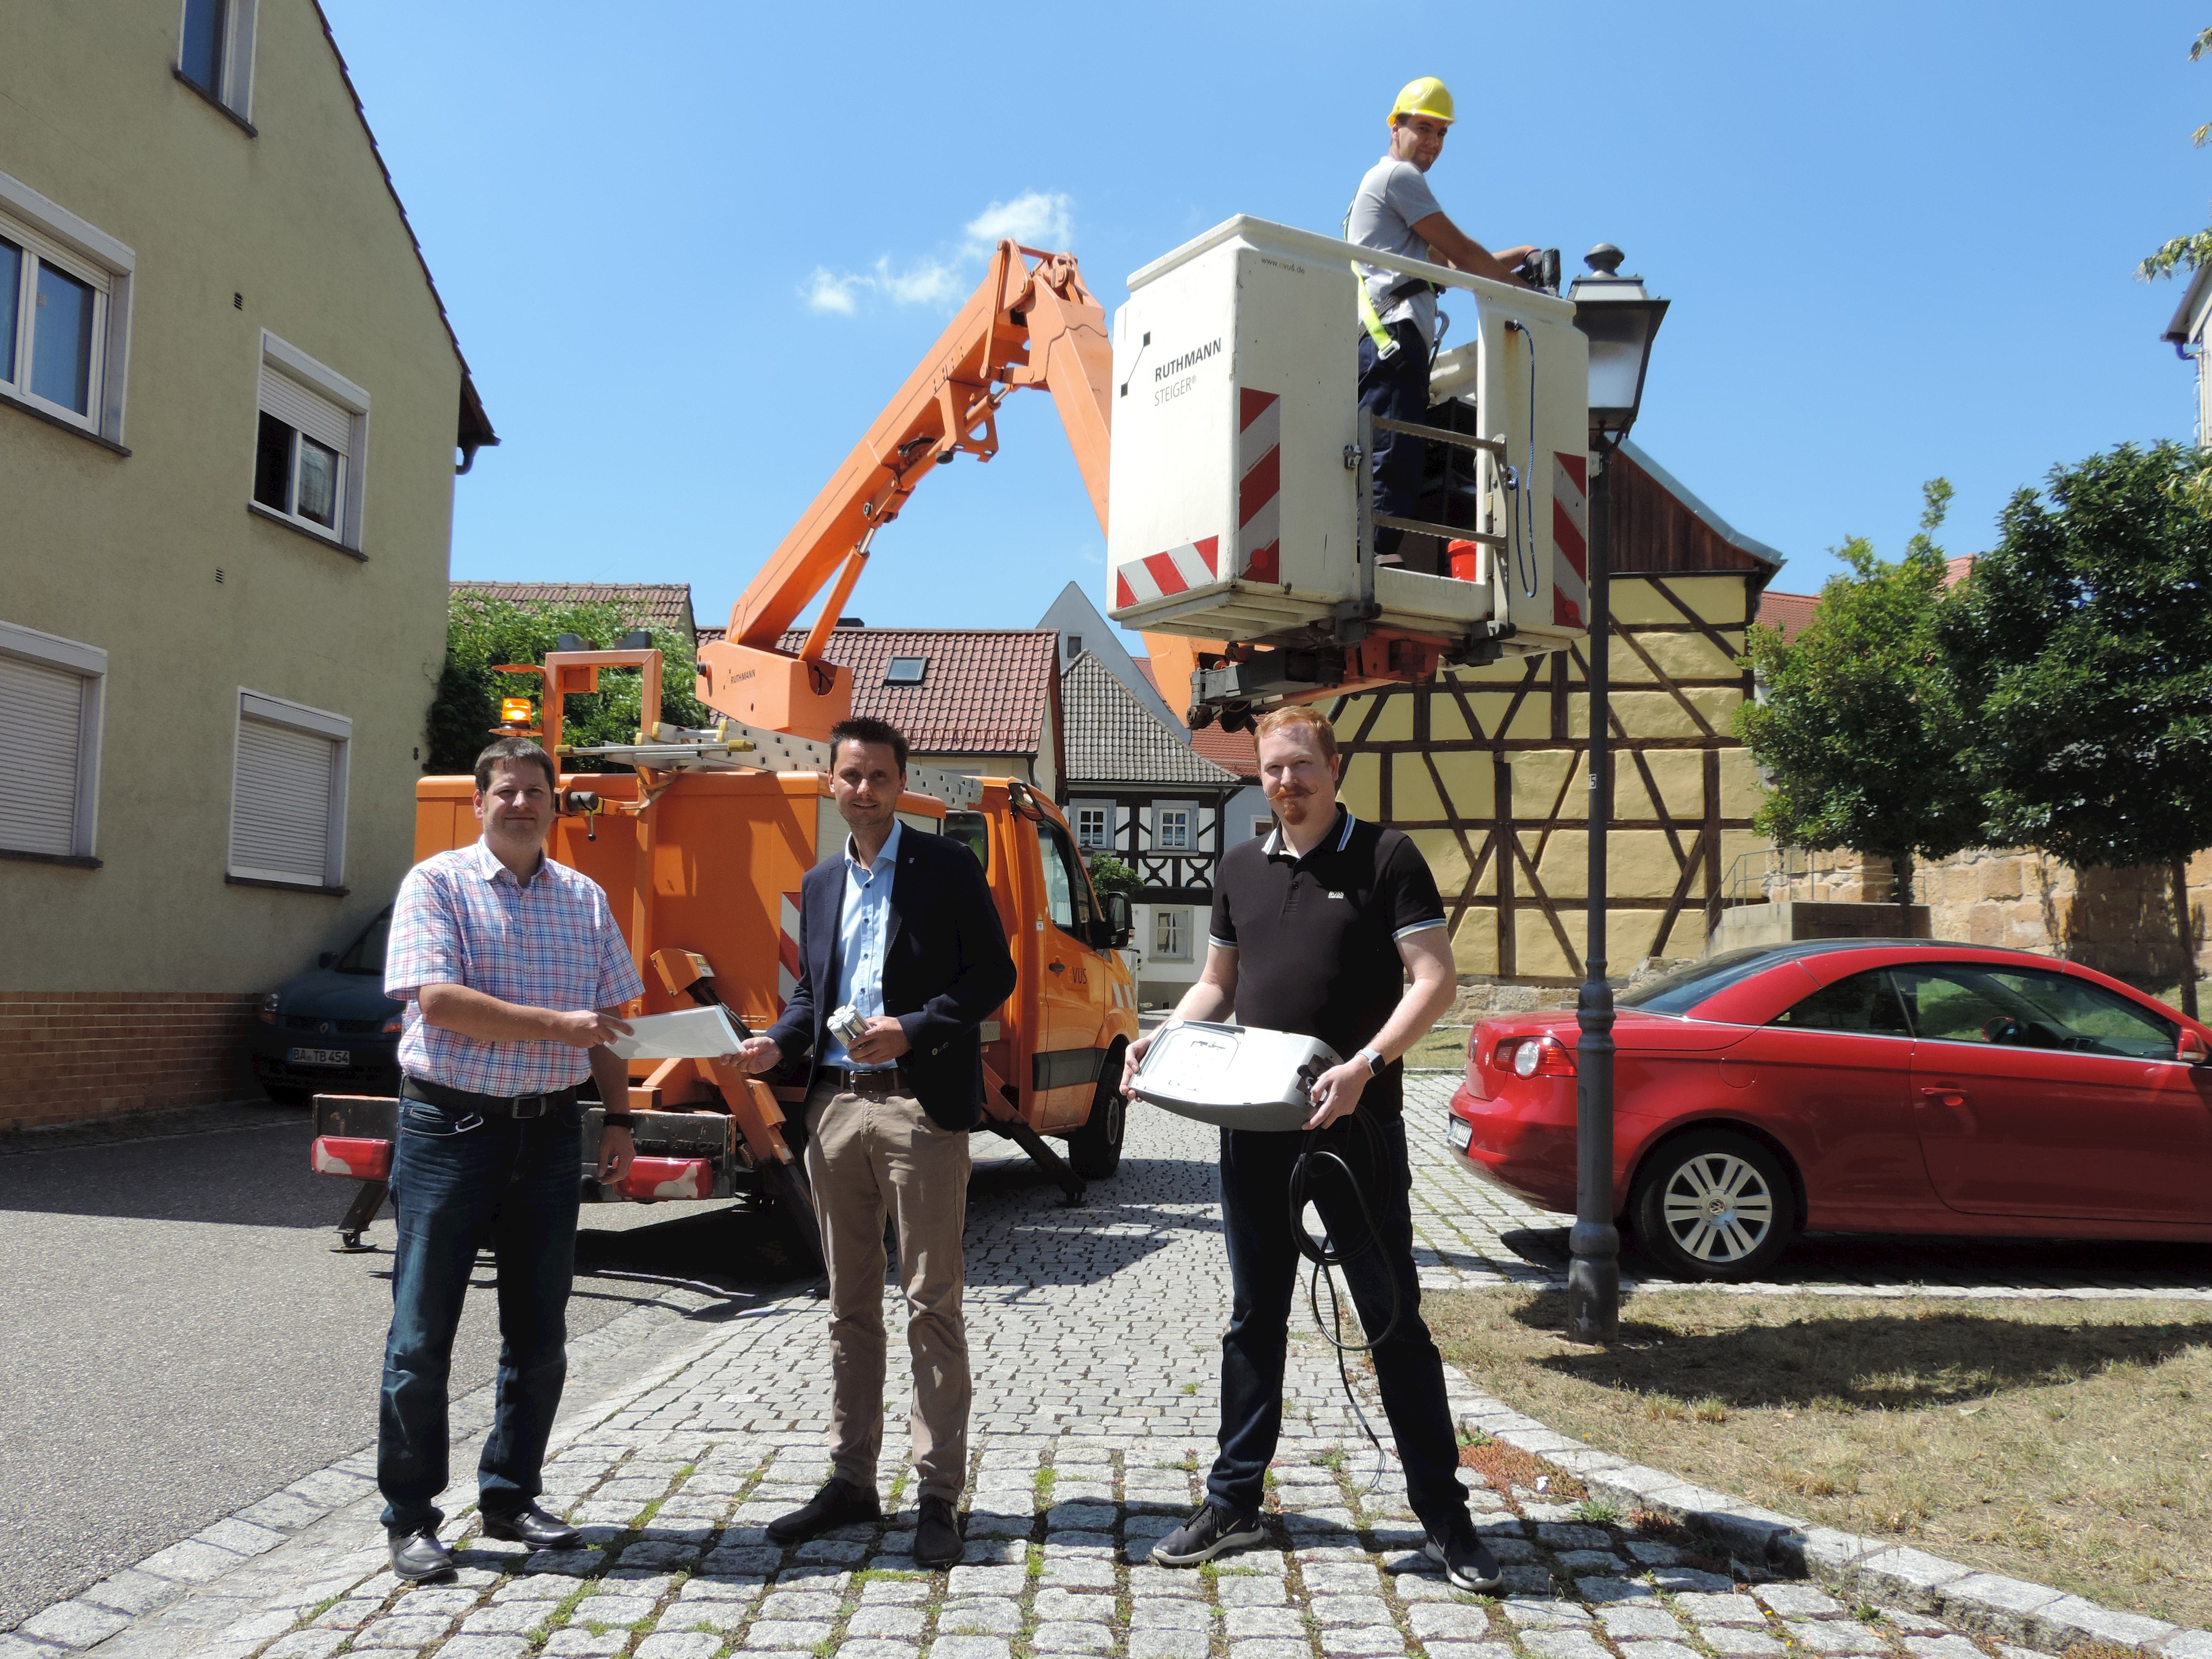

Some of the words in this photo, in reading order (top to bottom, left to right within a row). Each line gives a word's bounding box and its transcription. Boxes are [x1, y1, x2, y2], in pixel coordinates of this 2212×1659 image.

[1155, 337, 1221, 382] RUTHMANN
[731, 669, 756, 684] RUTHMANN
[293, 1049, 306, 1060] BA
[313, 1050, 326, 1062] TB
[328, 1051, 348, 1063] 454
